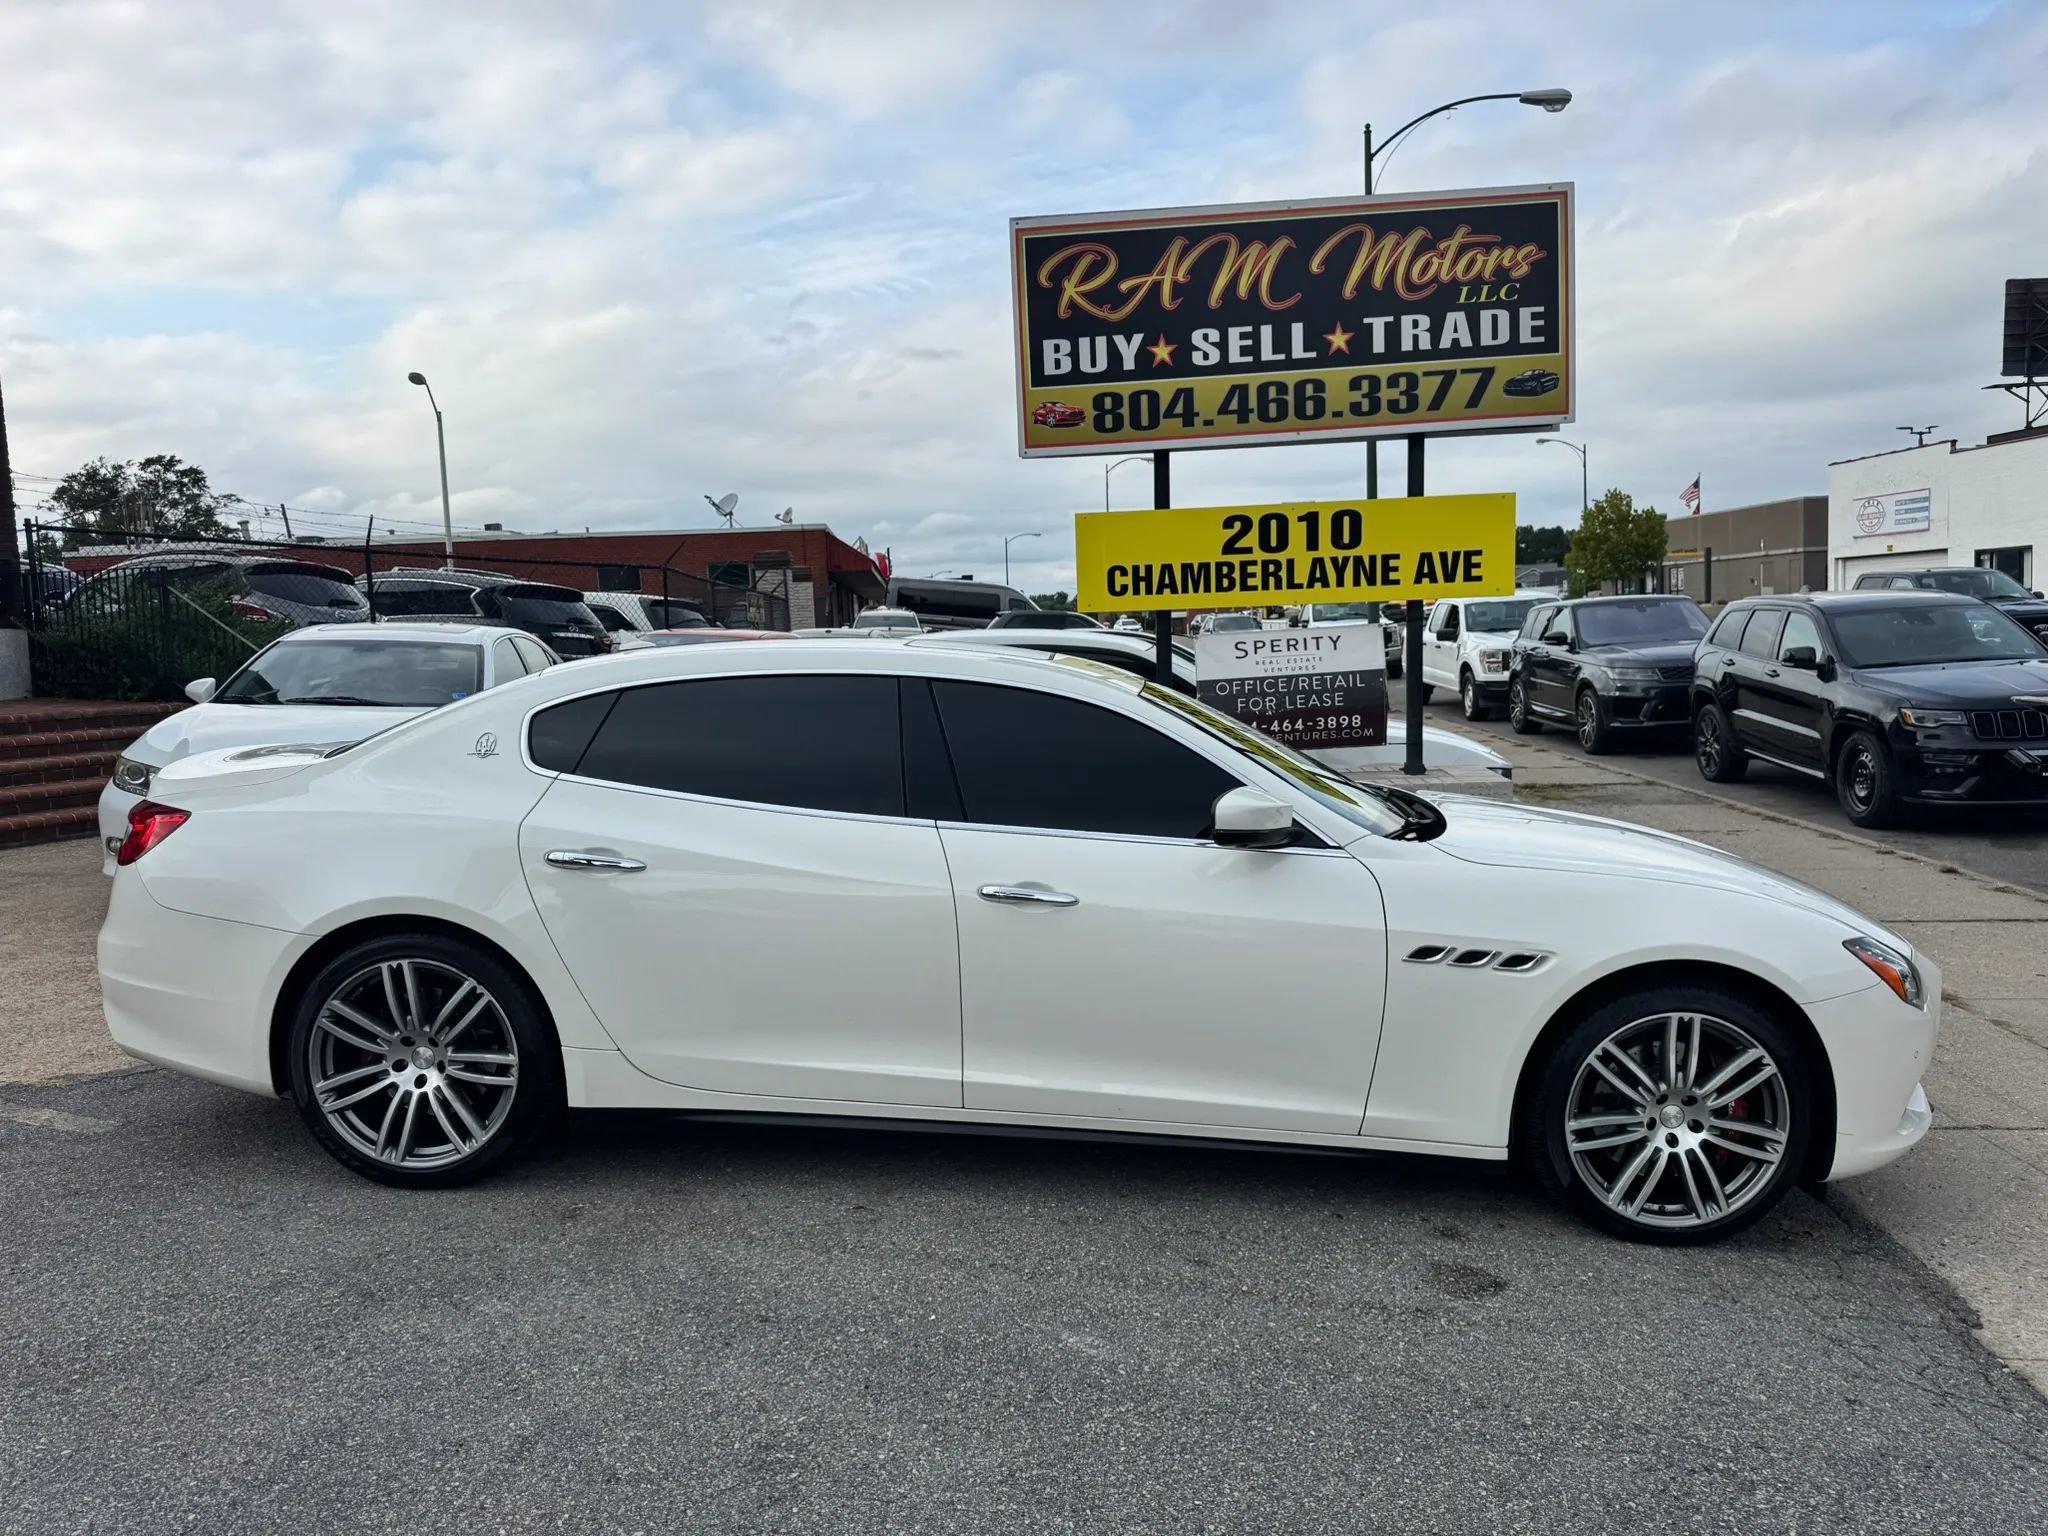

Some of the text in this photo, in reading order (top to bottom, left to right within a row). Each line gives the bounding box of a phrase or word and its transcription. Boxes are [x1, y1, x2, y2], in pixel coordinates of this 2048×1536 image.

[1037, 223, 1548, 322] RAM Motors
[1456, 282, 1521, 304] LLC
[1042, 306, 1546, 376] BUY SELL TRADE
[1092, 366, 1496, 434] 804.466.3377
[1221, 509, 1363, 556] 2010
[1106, 549, 1484, 598] CHAMBERLAYNE AVE
[1234, 635, 1342, 659] SPERITY
[1255, 656, 1324, 666] REAL ESTATE
[1263, 664, 1317, 673] VENTURES
[1215, 673, 1366, 696] OFFICE/RETAIL
[1236, 692, 1345, 713] FOR LEASE
[1251, 715, 1361, 733] 4-464-3898
[1271, 728, 1374, 741] ENTURES.COM
